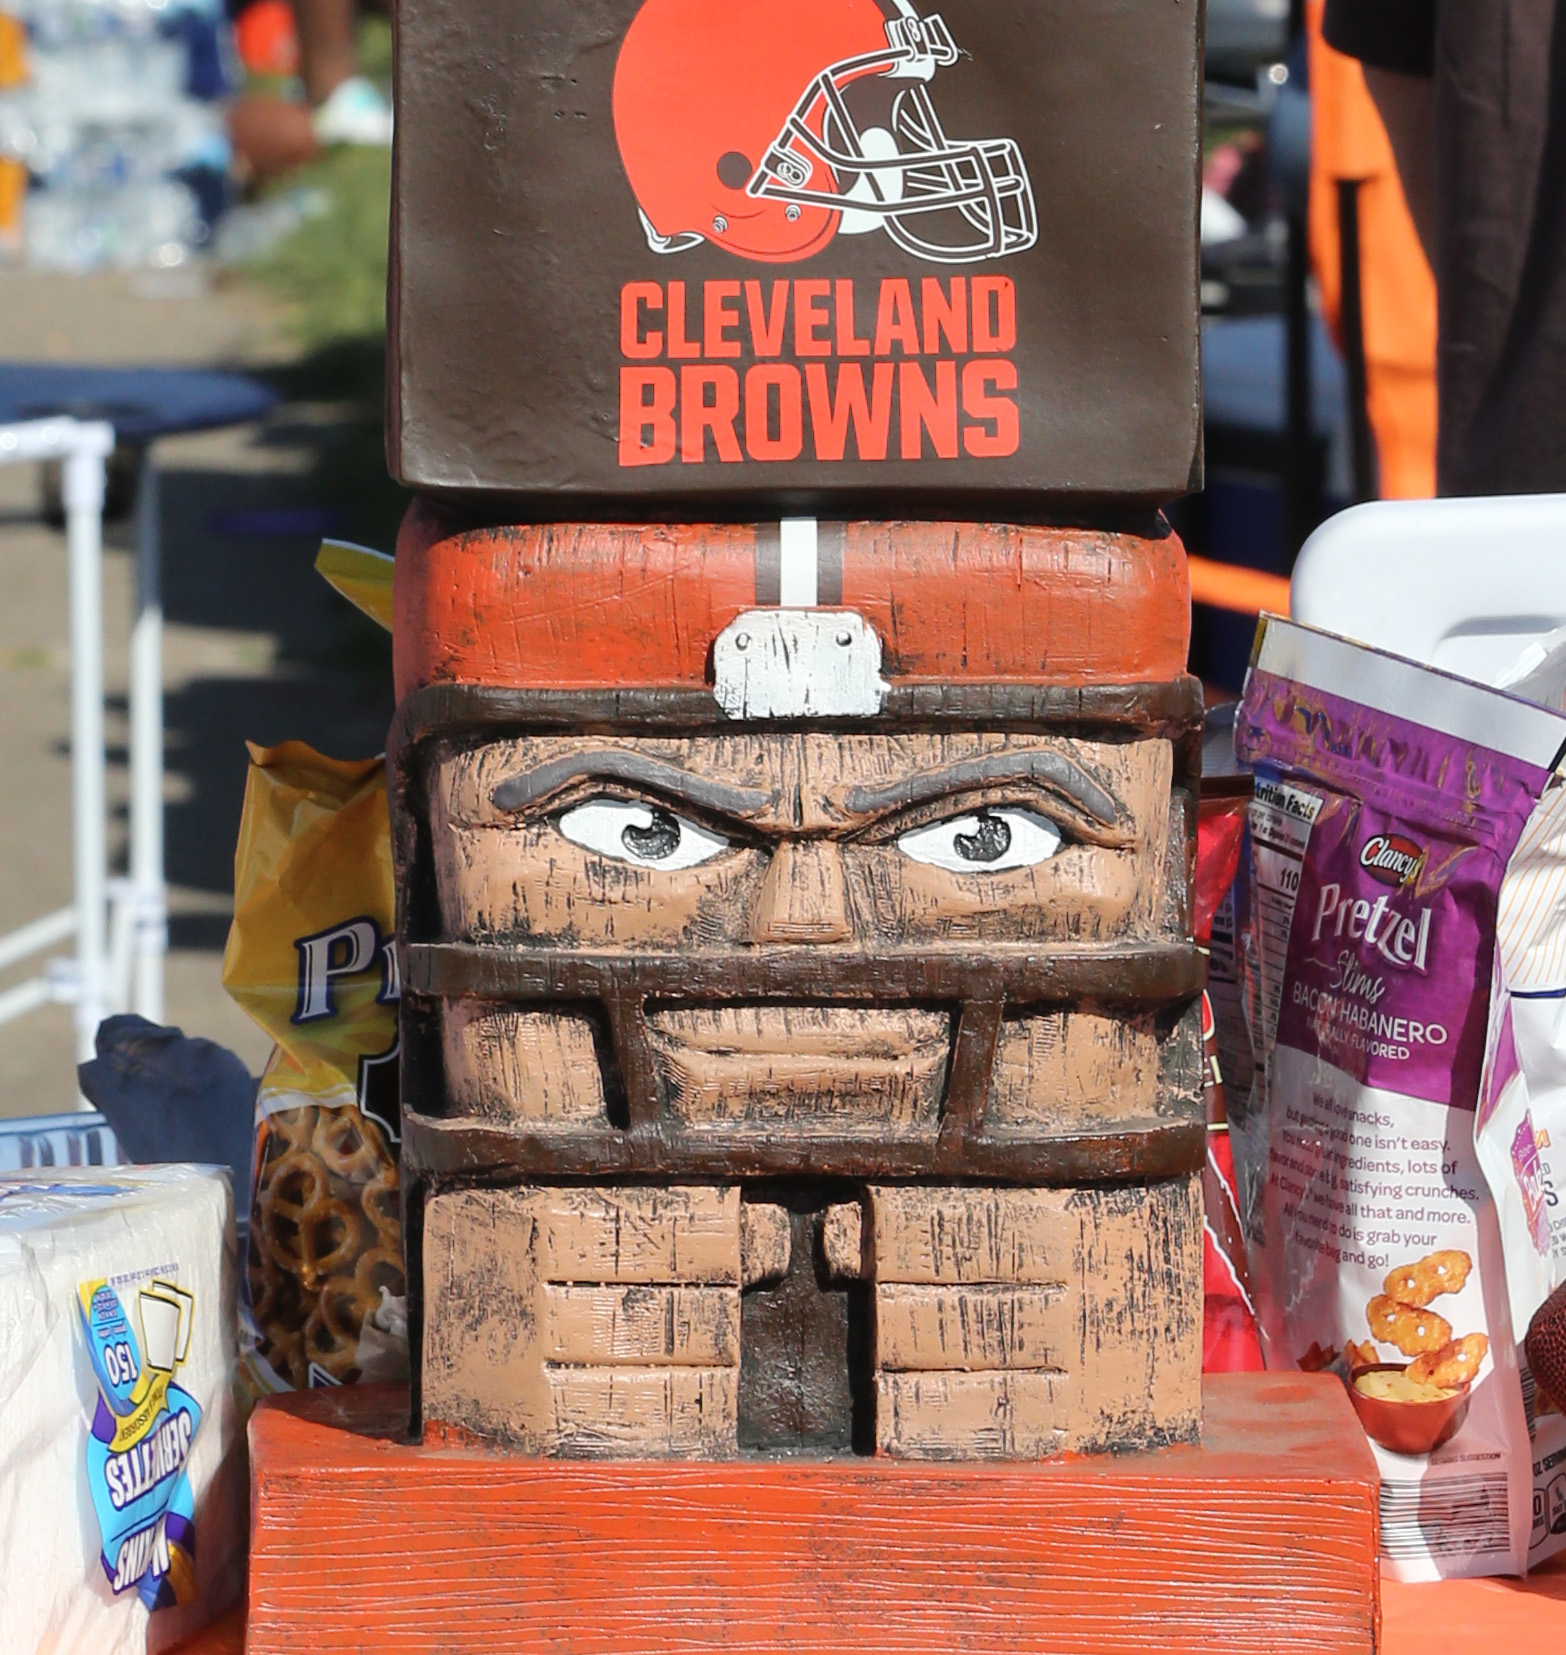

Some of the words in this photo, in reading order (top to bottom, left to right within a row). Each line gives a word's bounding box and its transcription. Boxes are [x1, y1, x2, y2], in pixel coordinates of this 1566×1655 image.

[620, 275, 1018, 359] CLEVELAND
[618, 359, 1020, 467] BROWNS
[1286, 794, 1315, 821] Facts
[1281, 867, 1299, 891] 110
[1312, 883, 1432, 972] Pretzel
[1329, 949, 1385, 1005] Slims
[1292, 981, 1339, 1015] BACON
[1339, 1001, 1448, 1045] HABANERO
[1351, 1030, 1410, 1060] FLAVORED
[1350, 1108, 1395, 1128] snacks,
[1349, 1132, 1372, 1148] one
[1375, 1133, 1409, 1150] isn't
[1410, 1137, 1450, 1154] easy.
[1408, 1159, 1438, 1174] lots
[1441, 1160, 1458, 1175] of
[1339, 1176, 1403, 1200] satisfying
[1407, 1184, 1480, 1201] crunches.
[1346, 1201, 1358, 1216] all
[1360, 1205, 1393, 1220] that
[1395, 1207, 1425, 1221] and
[1427, 1210, 1471, 1224] more.
[1338, 1223, 1352, 1239] do
[1352, 1227, 1364, 1241] is
[1366, 1230, 1401, 1246] grab
[1404, 1234, 1438, 1248] your
[1342, 1248, 1366, 1265] and
[1367, 1253, 1389, 1270] go!
[104, 1341, 139, 1389] 150
